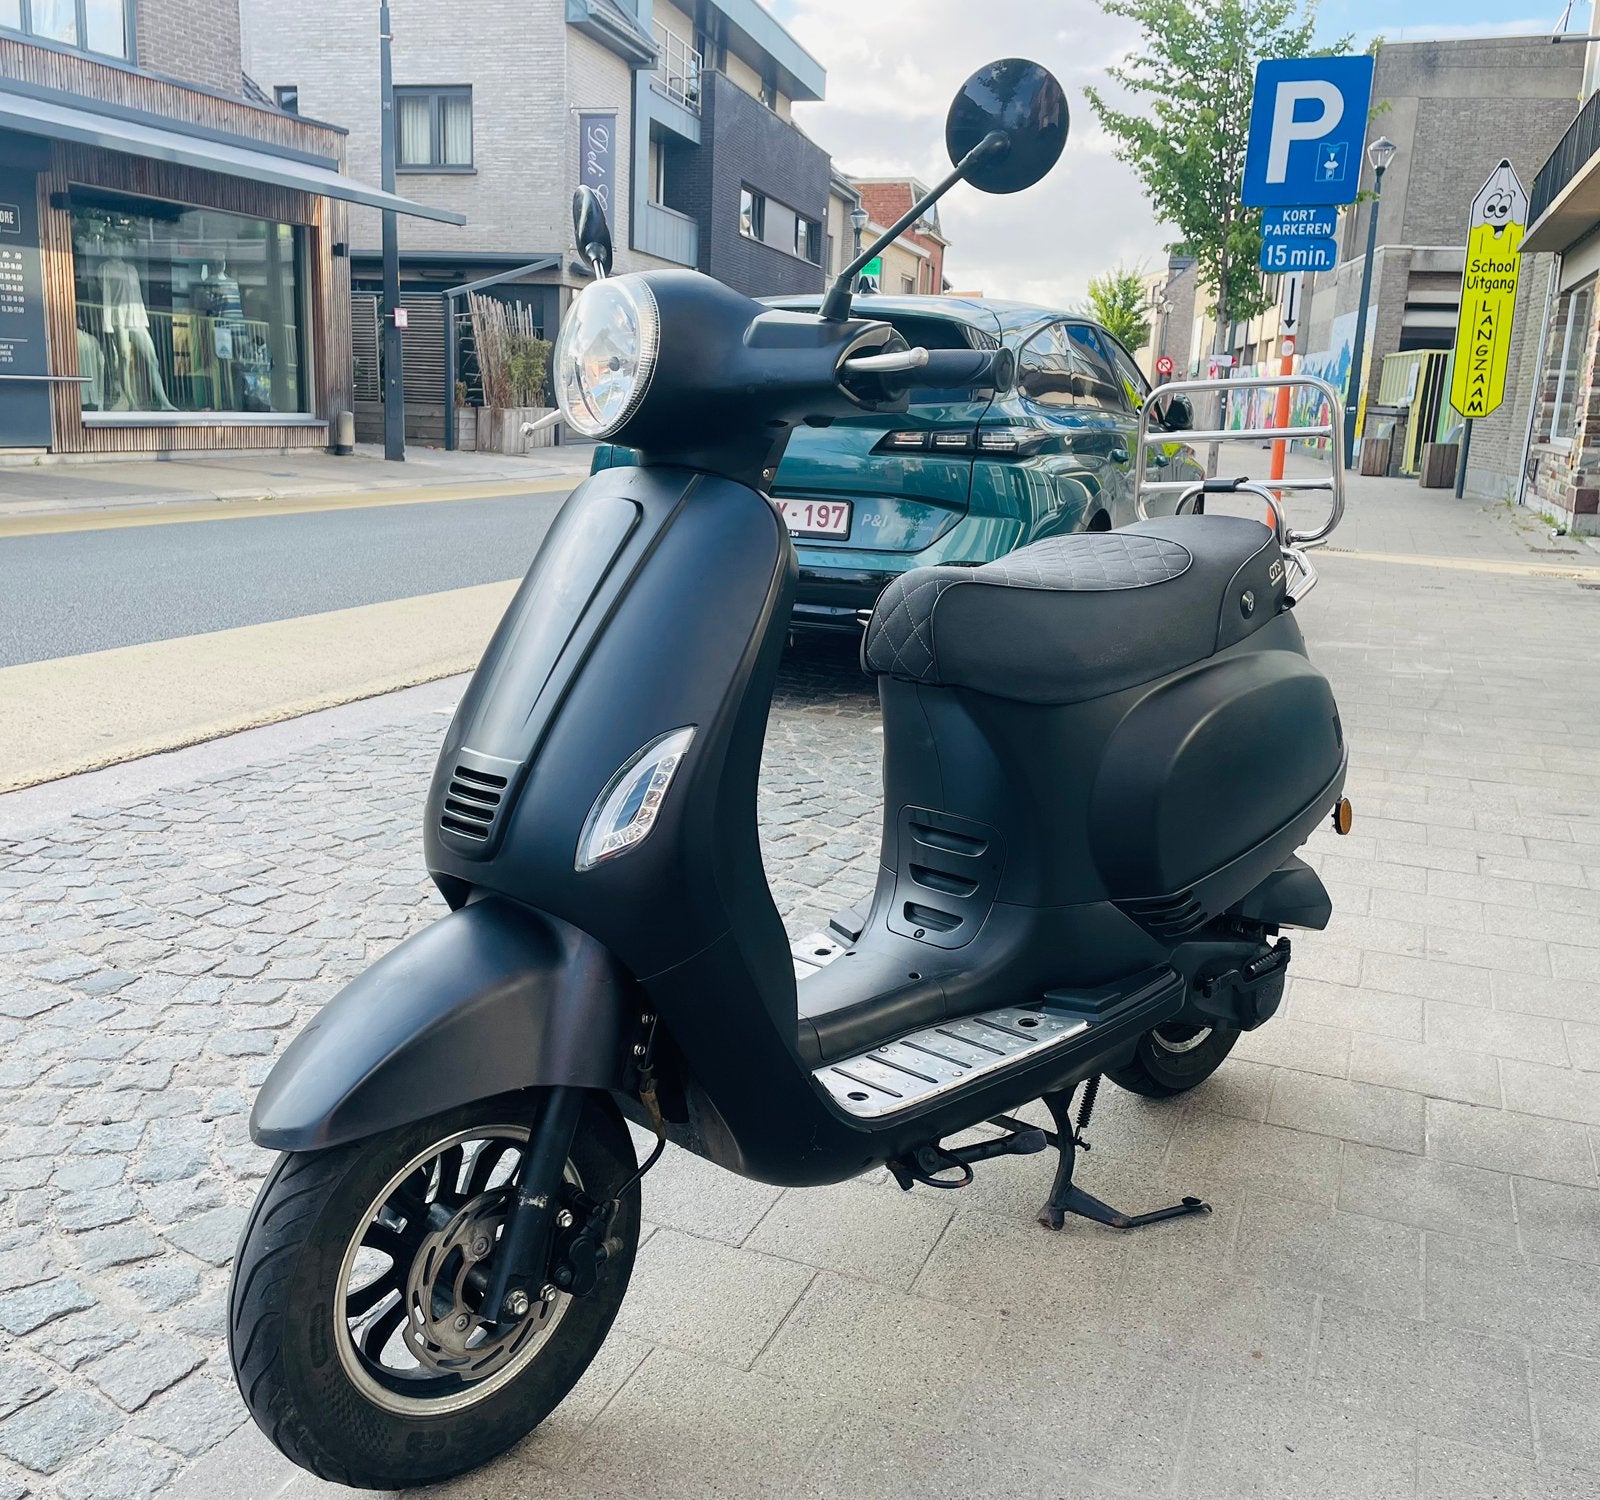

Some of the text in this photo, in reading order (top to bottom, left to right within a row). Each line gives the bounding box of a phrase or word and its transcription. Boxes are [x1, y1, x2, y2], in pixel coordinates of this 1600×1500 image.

[1265, 80, 1344, 184] P
[587, 123, 609, 177] Deli
[1282, 209, 1317, 222] KORT
[1264, 223, 1332, 236] PARKEREN
[1266, 245, 1330, 266] 15 min.
[1470, 258, 1516, 273] School
[1466, 275, 1515, 293] Uitgang
[1467, 300, 1493, 412] LANGZAAM
[861, 513, 888, 528] P&I
